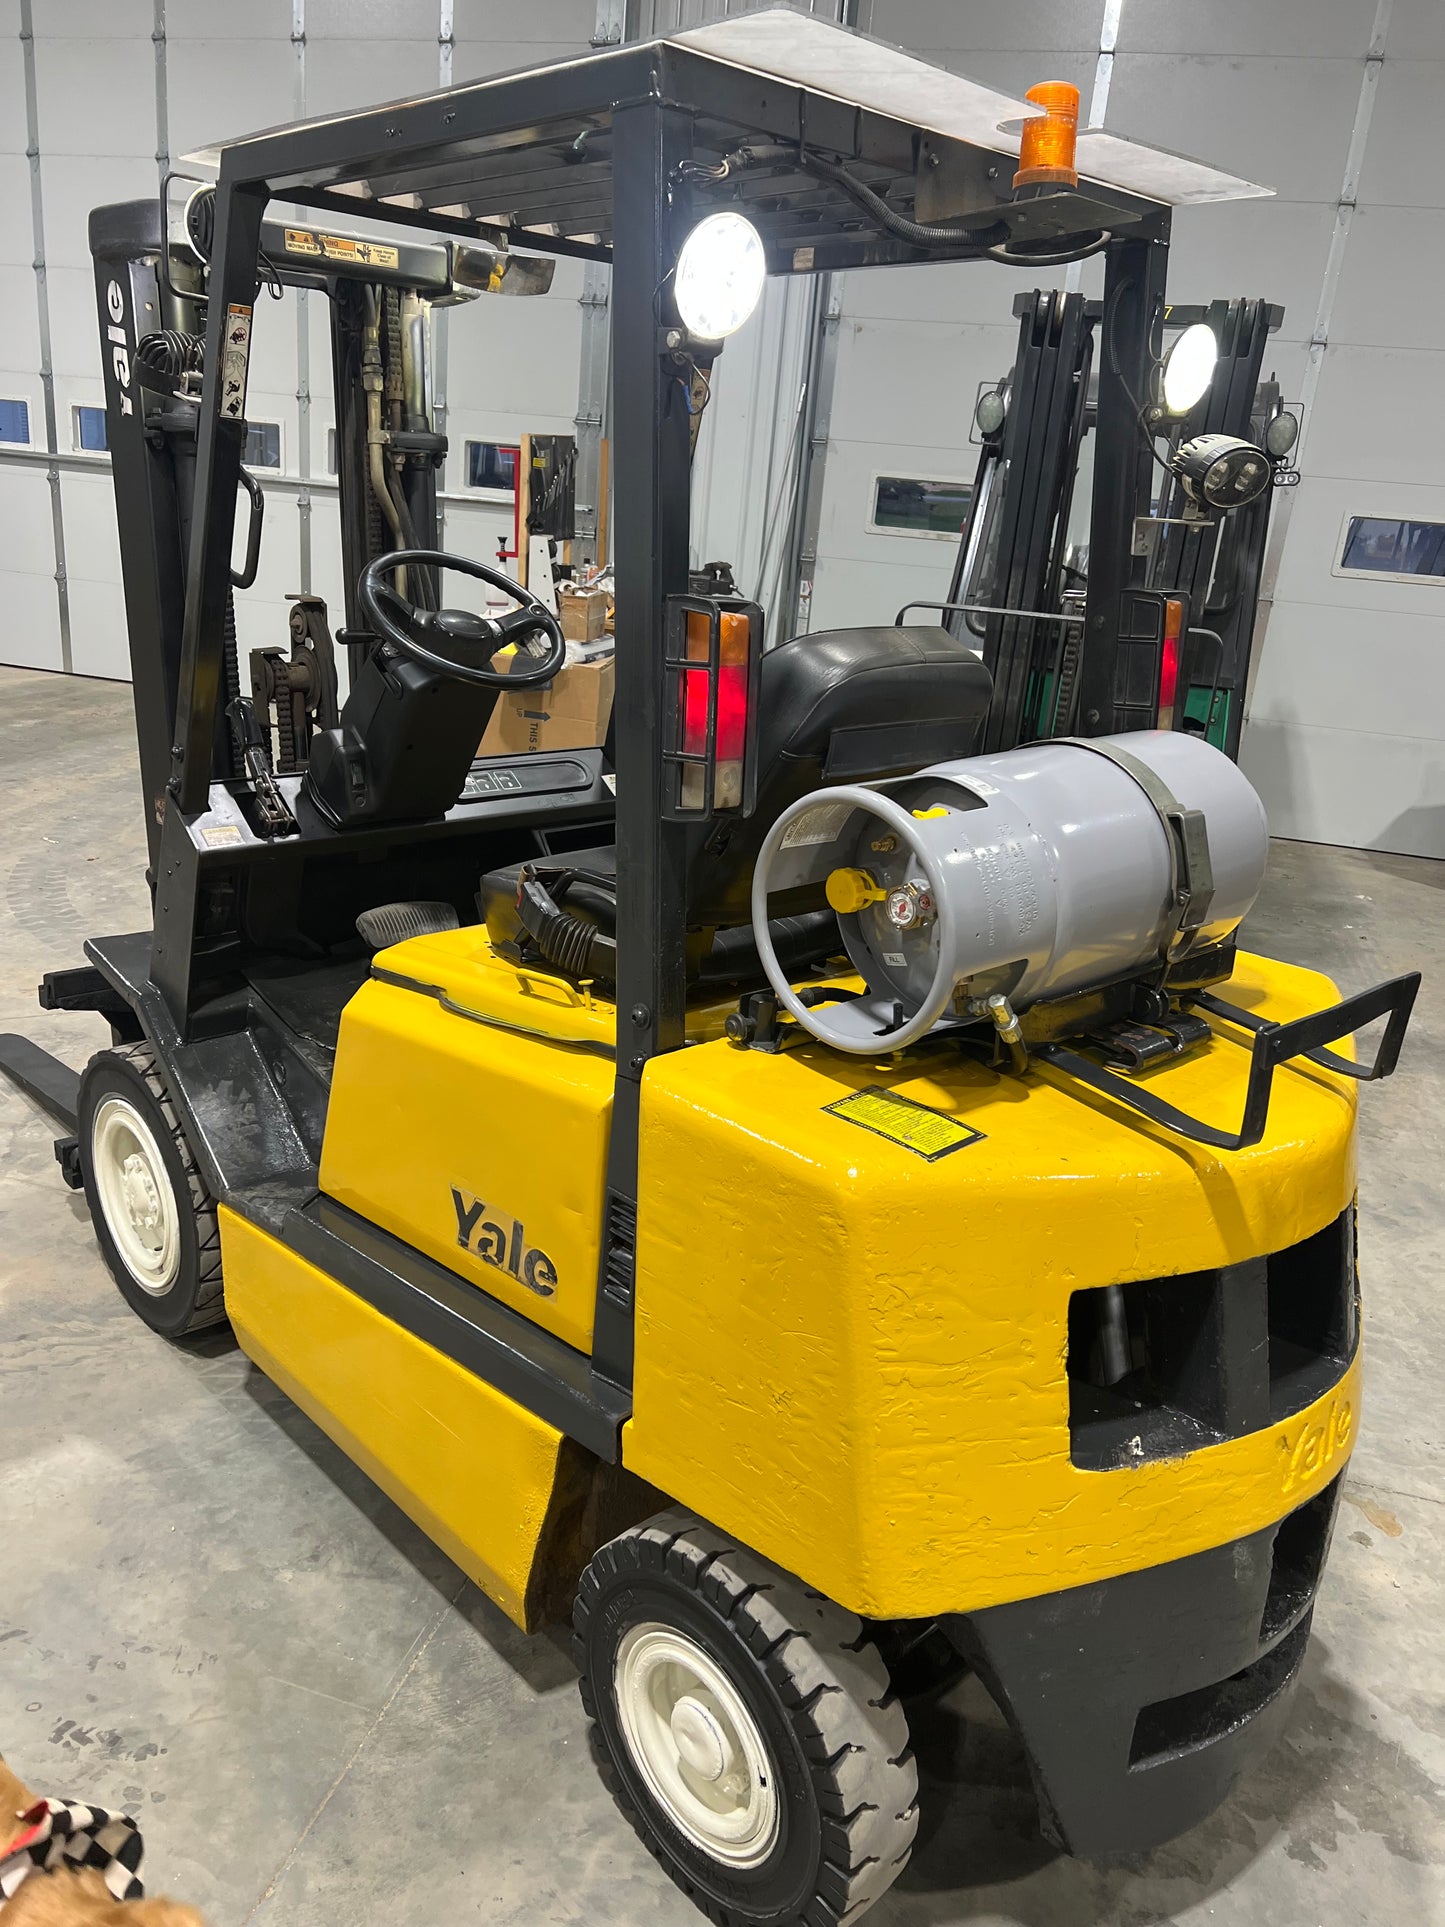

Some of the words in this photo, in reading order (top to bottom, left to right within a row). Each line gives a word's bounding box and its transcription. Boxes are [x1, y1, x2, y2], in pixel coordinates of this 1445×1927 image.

[529, 722, 539, 743] THIS
[451, 1187, 558, 1297] Yale
[1276, 1400, 1352, 1493] Yale
